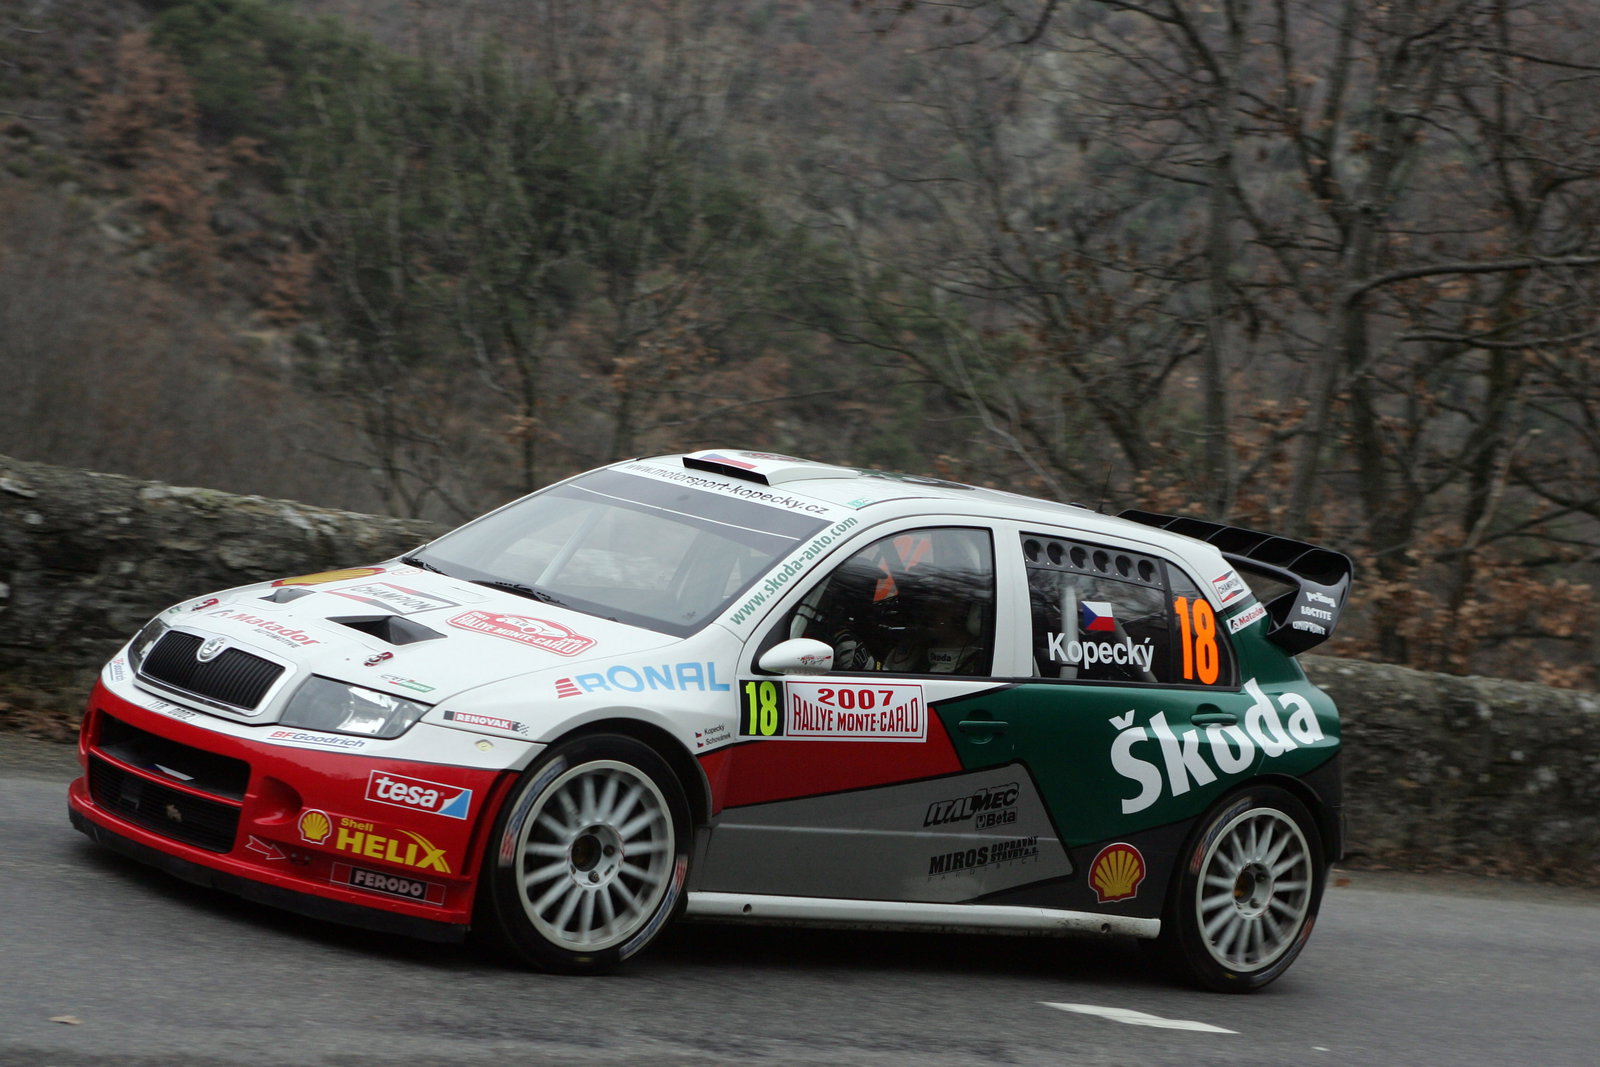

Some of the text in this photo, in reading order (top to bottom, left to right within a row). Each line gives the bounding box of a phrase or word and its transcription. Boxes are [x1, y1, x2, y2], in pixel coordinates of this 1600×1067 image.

[729, 517, 858, 625] www.skoda-auto.com
[350, 584, 438, 611] CHAMPION
[1301, 606, 1332, 621] LOCTITE
[230, 613, 320, 646] Matador
[1239, 607, 1265, 625] Matador
[455, 614, 584, 653] RALLYE MONTE-CARLO
[1174, 596, 1219, 685] 18
[1048, 632, 1154, 672] Kopecký
[575, 661, 731, 693] RONAL
[745, 681, 778, 736] 18
[792, 693, 834, 731] RALLYE
[818, 688, 894, 710] 2007
[456, 712, 512, 729] RENOVAK
[270, 730, 365, 748] BFGoodrich
[1108, 677, 1325, 814] Škoda
[375, 775, 438, 808] tesa
[923, 782, 1020, 827] ITALMEC
[340, 817, 373, 832] Shell
[986, 810, 1016, 827] Beta
[335, 827, 451, 873] HELIX
[928, 846, 988, 874] MIROS
[354, 869, 424, 897] FERODO
